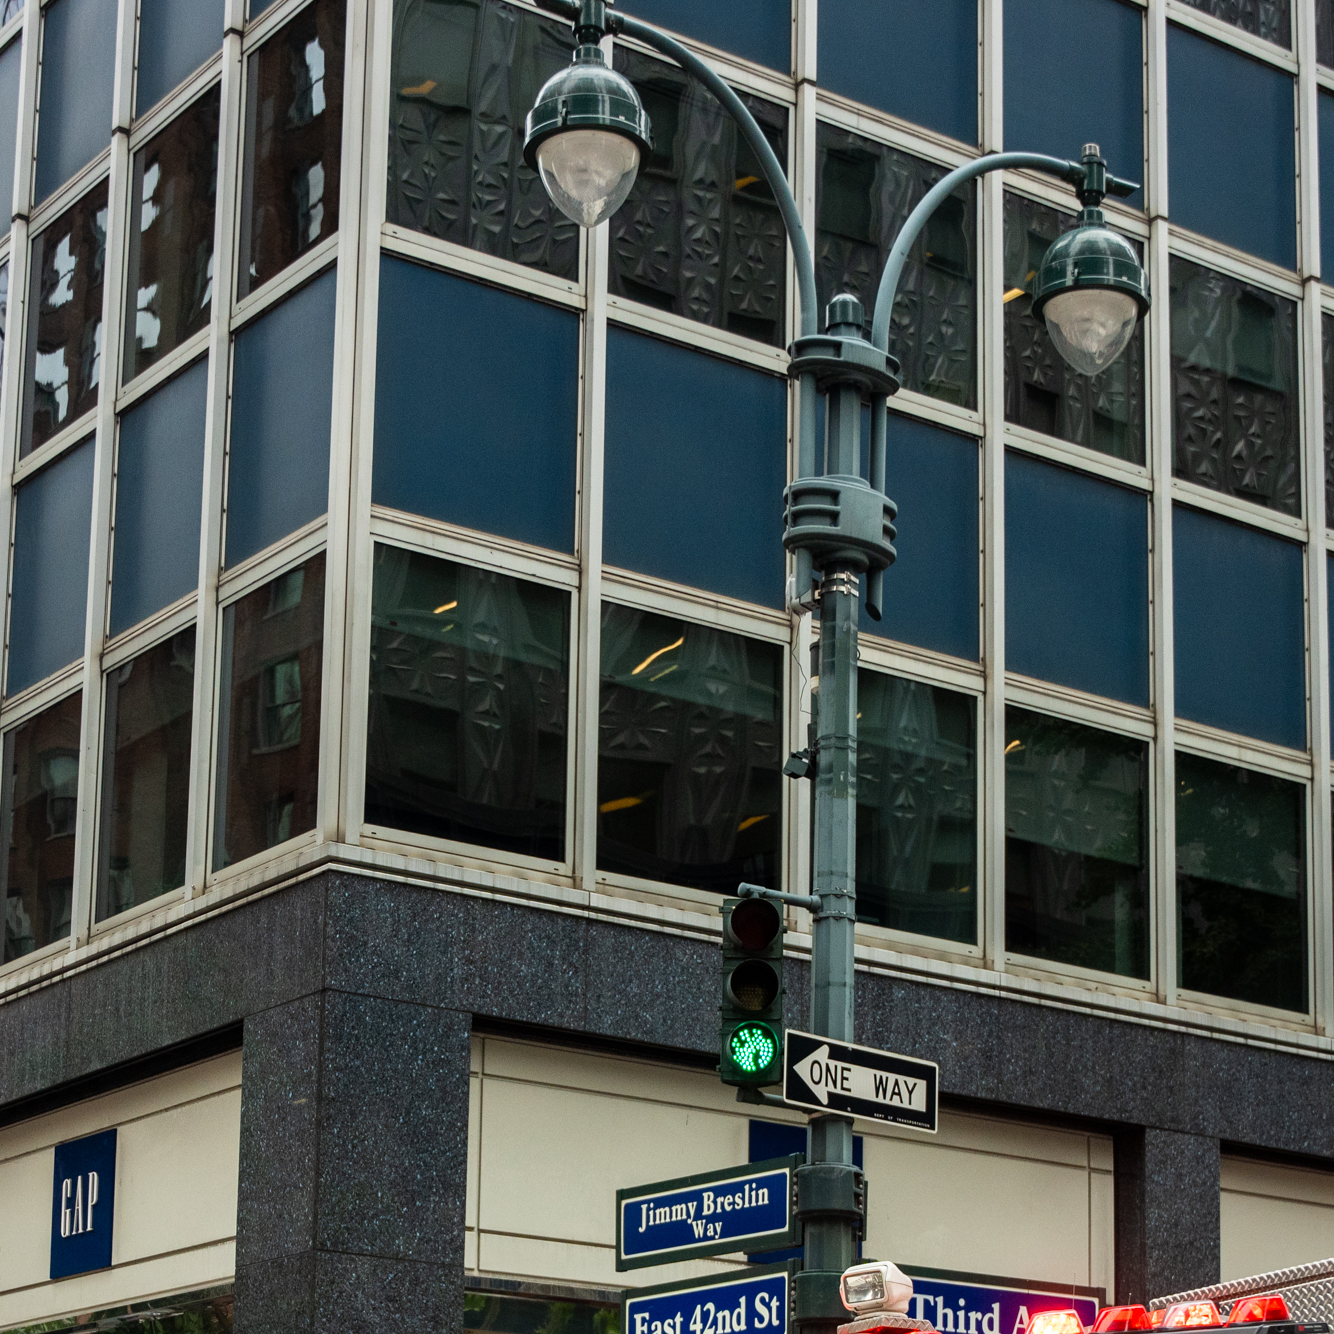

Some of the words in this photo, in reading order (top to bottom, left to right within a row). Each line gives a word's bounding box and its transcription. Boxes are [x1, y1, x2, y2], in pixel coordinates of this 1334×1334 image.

[810, 1060, 851, 1092] ONE
[874, 1074, 917, 1105] WAY
[897, 1117, 930, 1128] TRANSPORTATION
[61, 1171, 99, 1238] GAP
[639, 1202, 697, 1232] Jimmy
[702, 1183, 769, 1216] Breslin
[692, 1220, 722, 1239] Way
[755, 1292, 779, 1328] St
